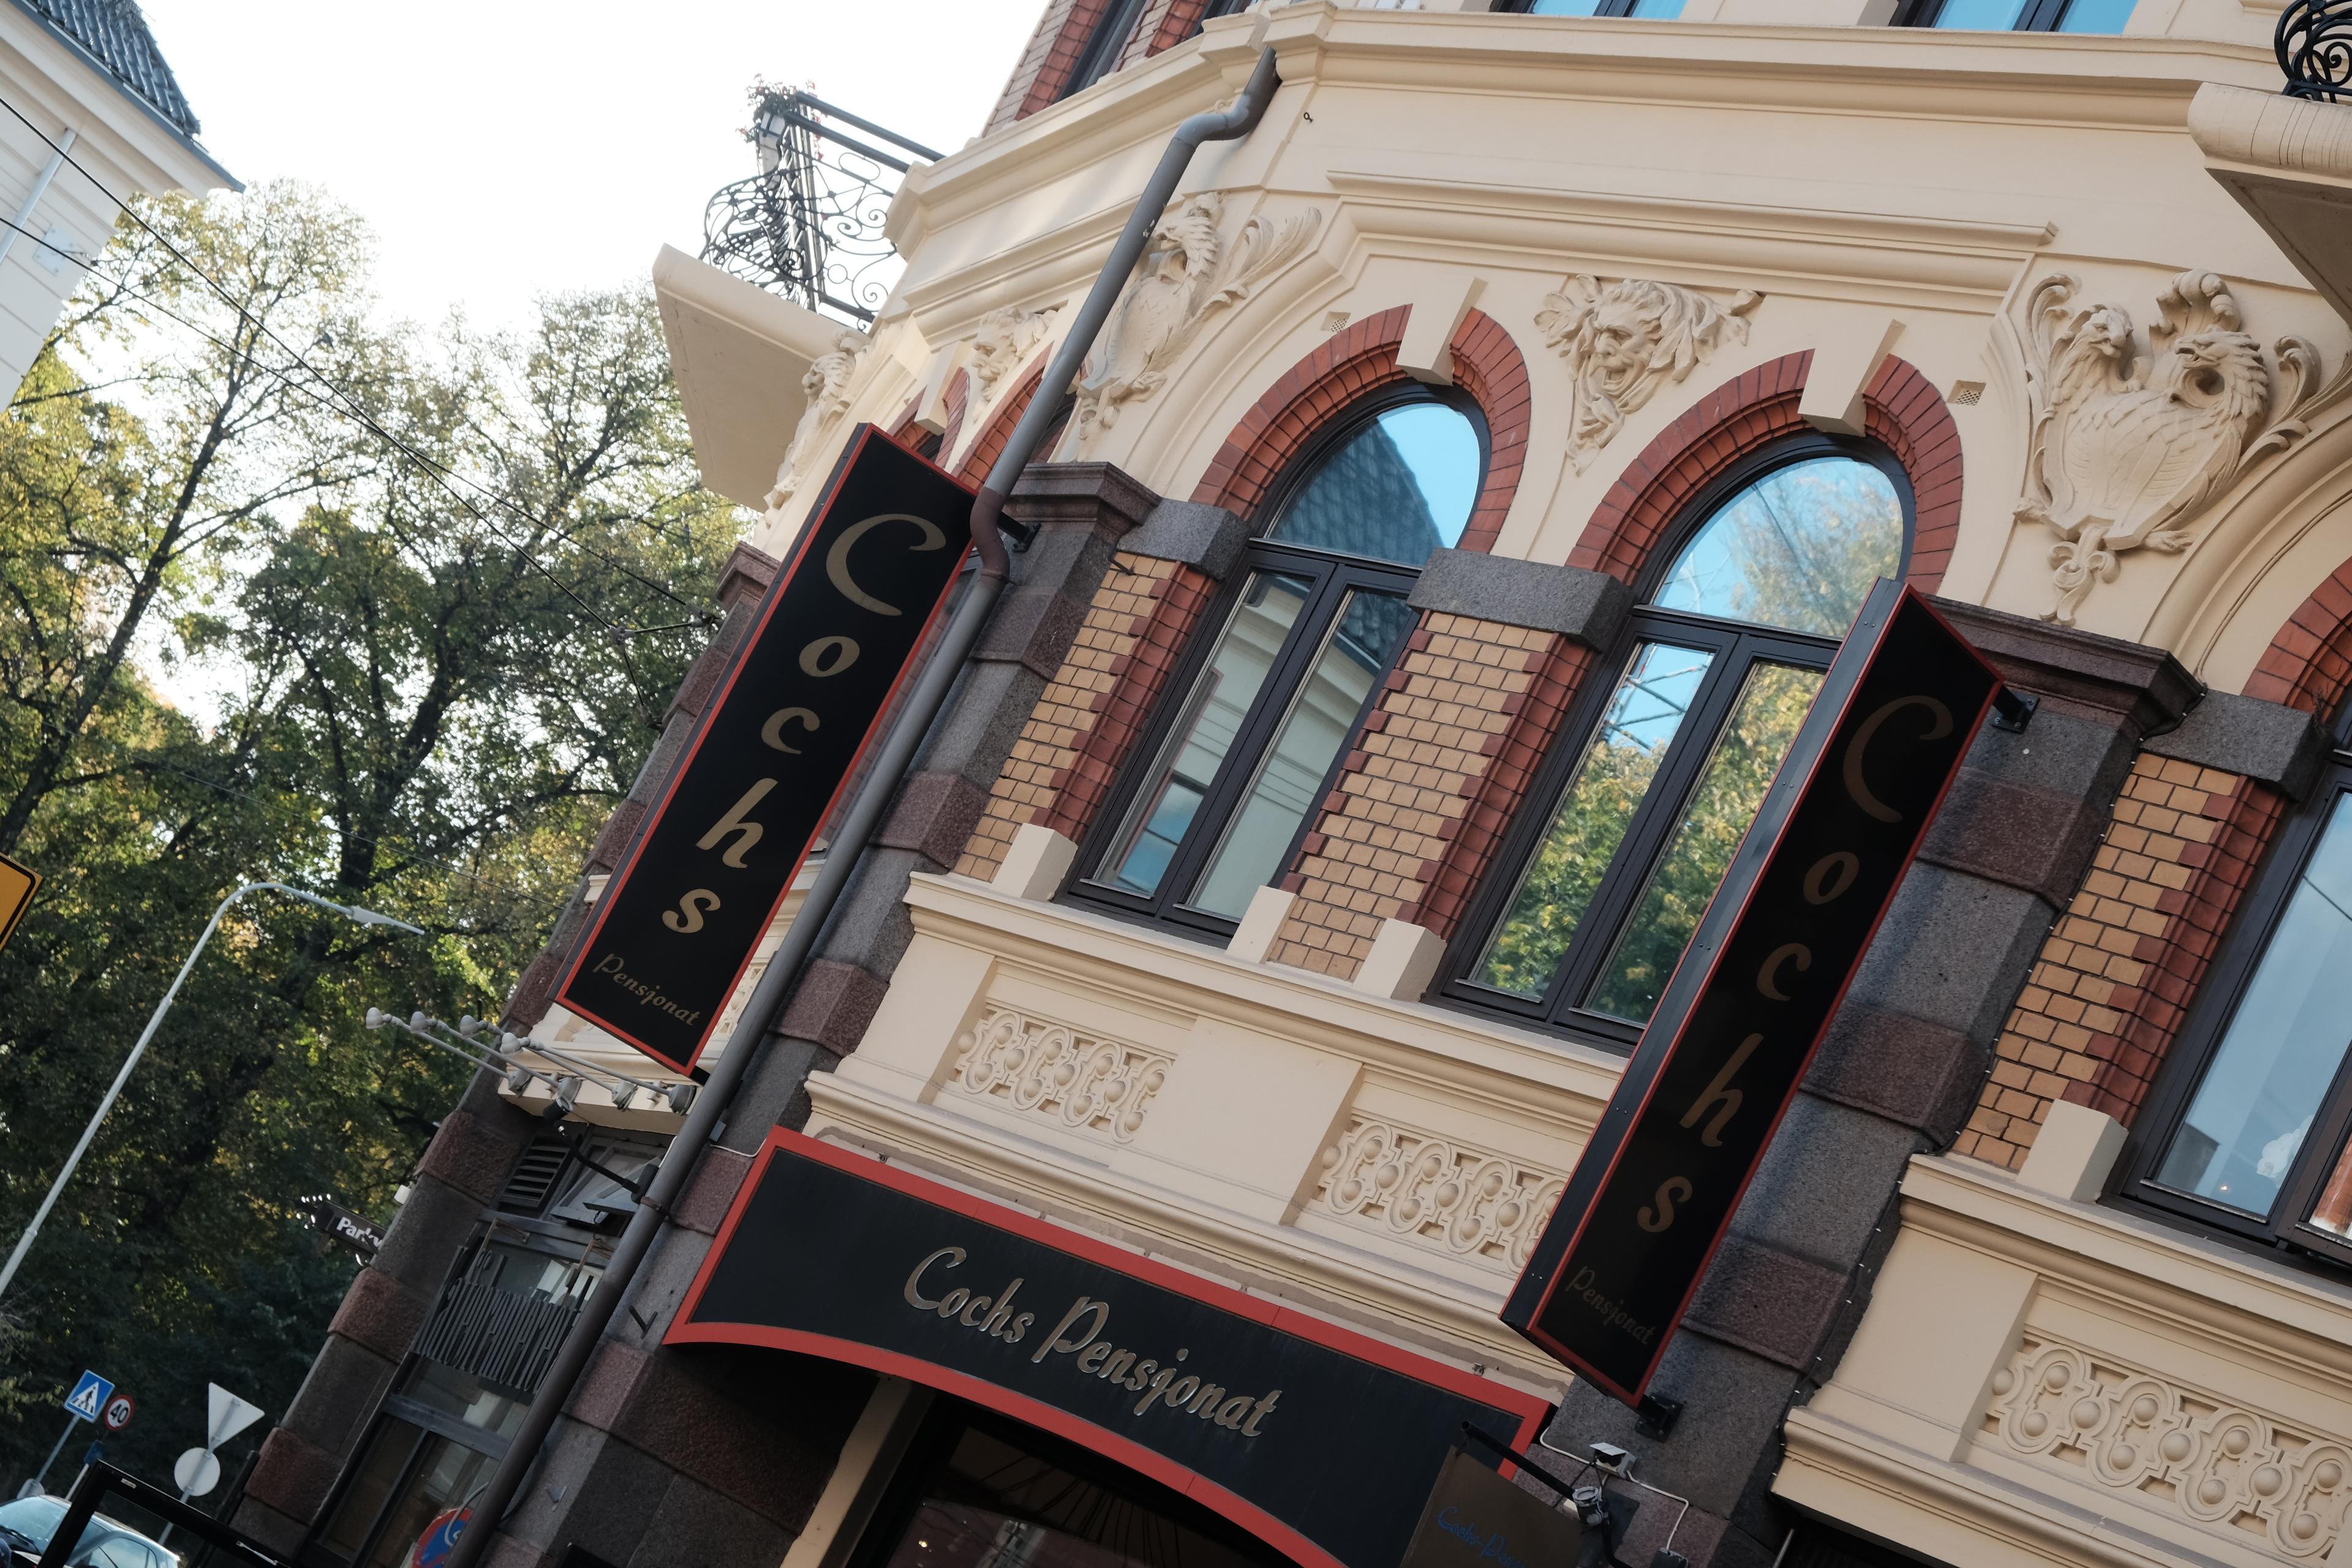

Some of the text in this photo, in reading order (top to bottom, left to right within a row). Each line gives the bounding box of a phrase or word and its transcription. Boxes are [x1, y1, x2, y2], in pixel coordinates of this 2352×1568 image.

[662, 513, 946, 933] Cochs
[593, 953, 701, 1026] Pensjonat
[1637, 695, 1953, 1234] Cochs
[903, 1246, 1283, 1437] Cochs Pensjonat
[1565, 1265, 1657, 1344] Pensjonat
[110, 1403, 129, 1423] 40
